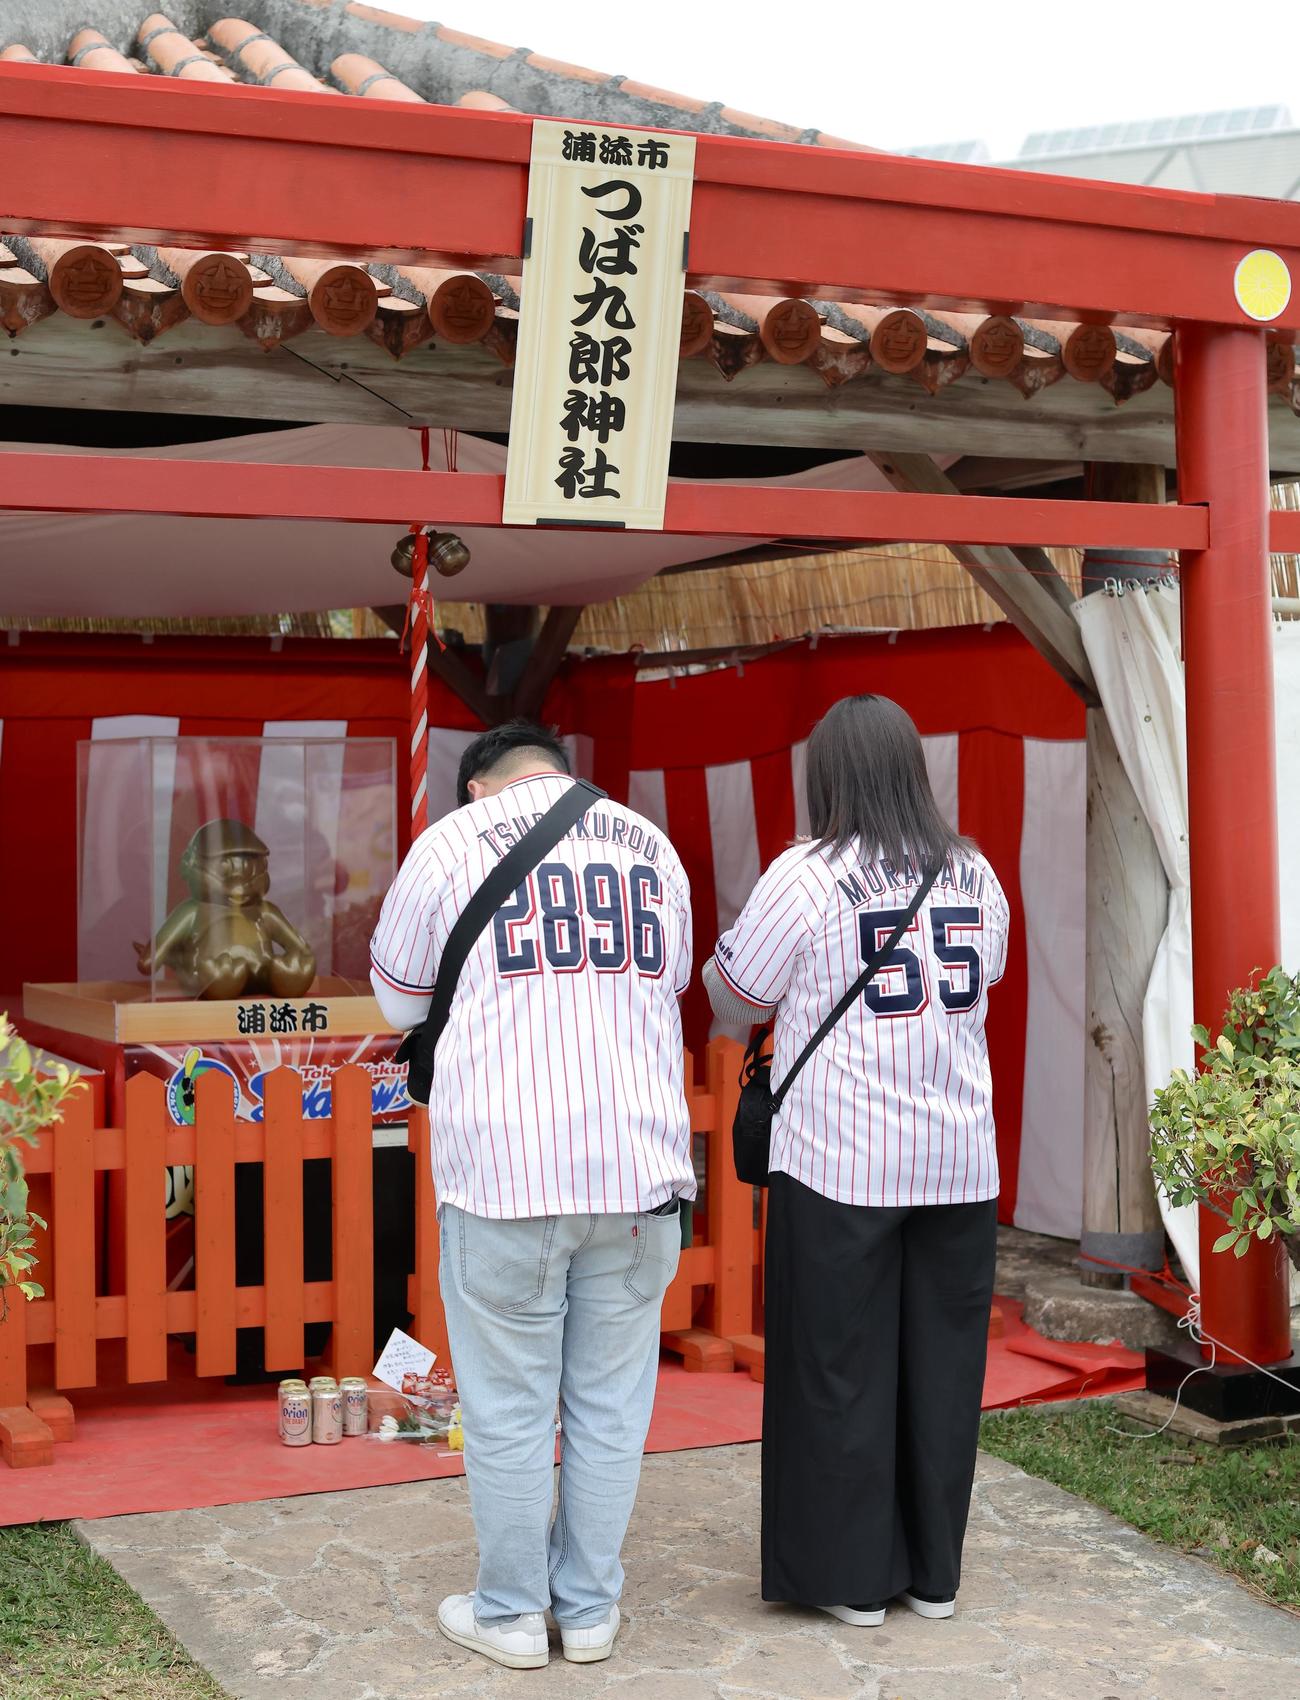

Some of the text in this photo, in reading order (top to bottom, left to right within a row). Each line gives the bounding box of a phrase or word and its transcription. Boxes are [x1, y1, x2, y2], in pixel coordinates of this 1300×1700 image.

[561, 130, 671, 170] 浦添市
[553, 179, 645, 499] つば九郎神社
[477, 811, 660, 864] TSUKUROU
[493, 862, 667, 980] 2896
[857, 906, 984, 1020] 55
[237, 1003, 329, 1034] 浦添市
[283, 1408, 308, 1418] Orion
